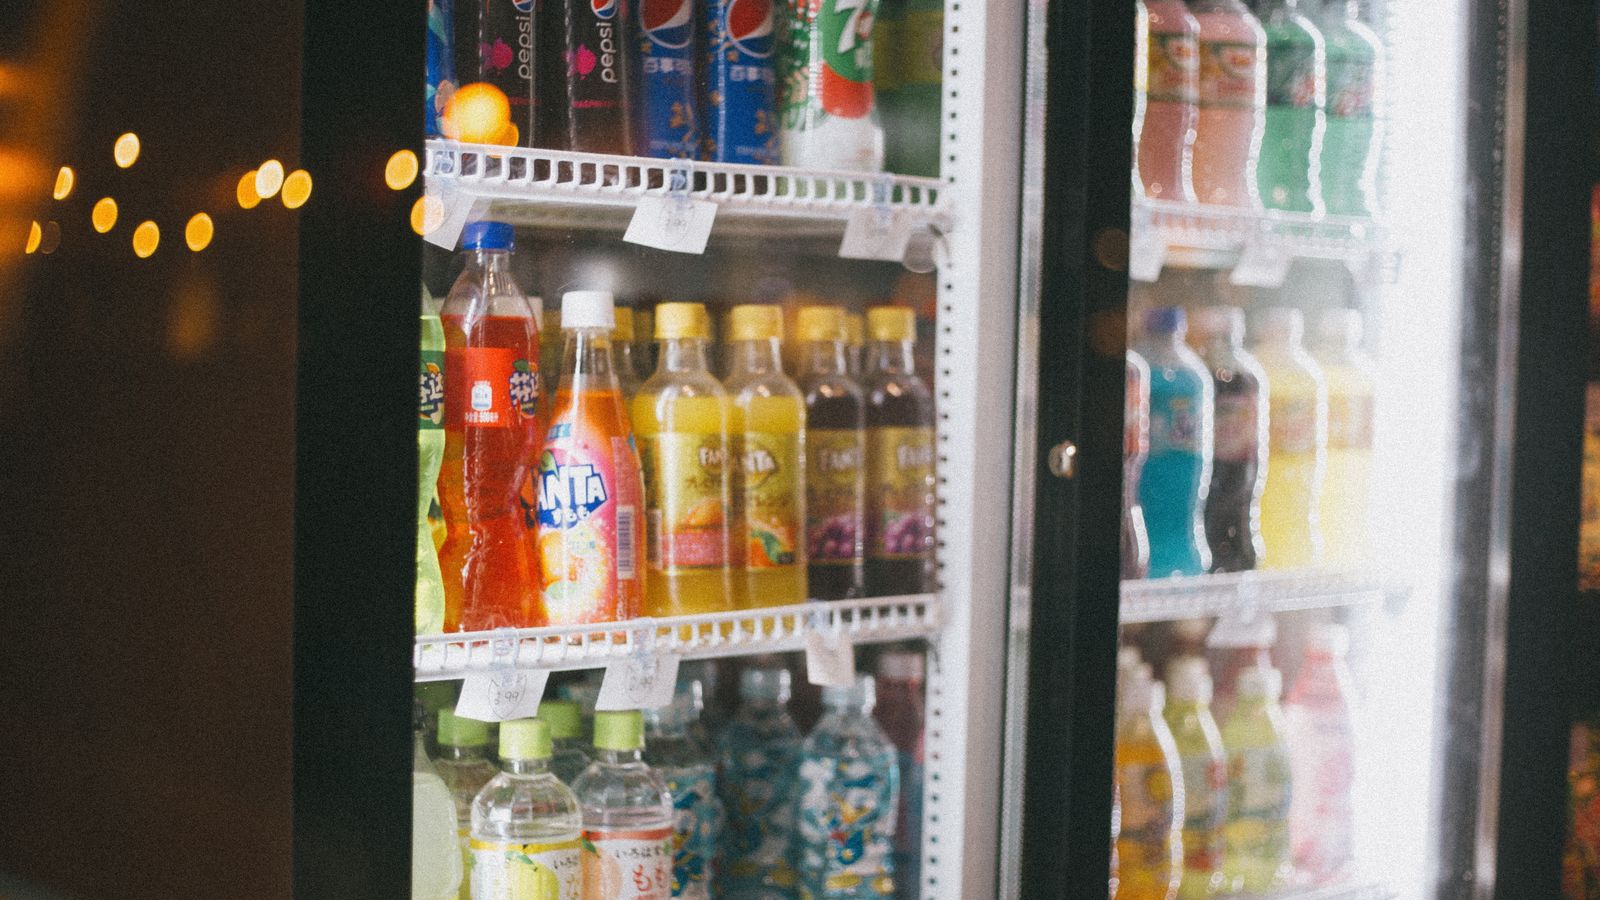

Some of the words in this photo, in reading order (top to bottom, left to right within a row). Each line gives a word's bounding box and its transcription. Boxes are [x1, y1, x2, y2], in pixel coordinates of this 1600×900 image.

[515, 16, 532, 79] pepsi
[596, 22, 618, 83] pepsi
[536, 465, 608, 512] ANTA
